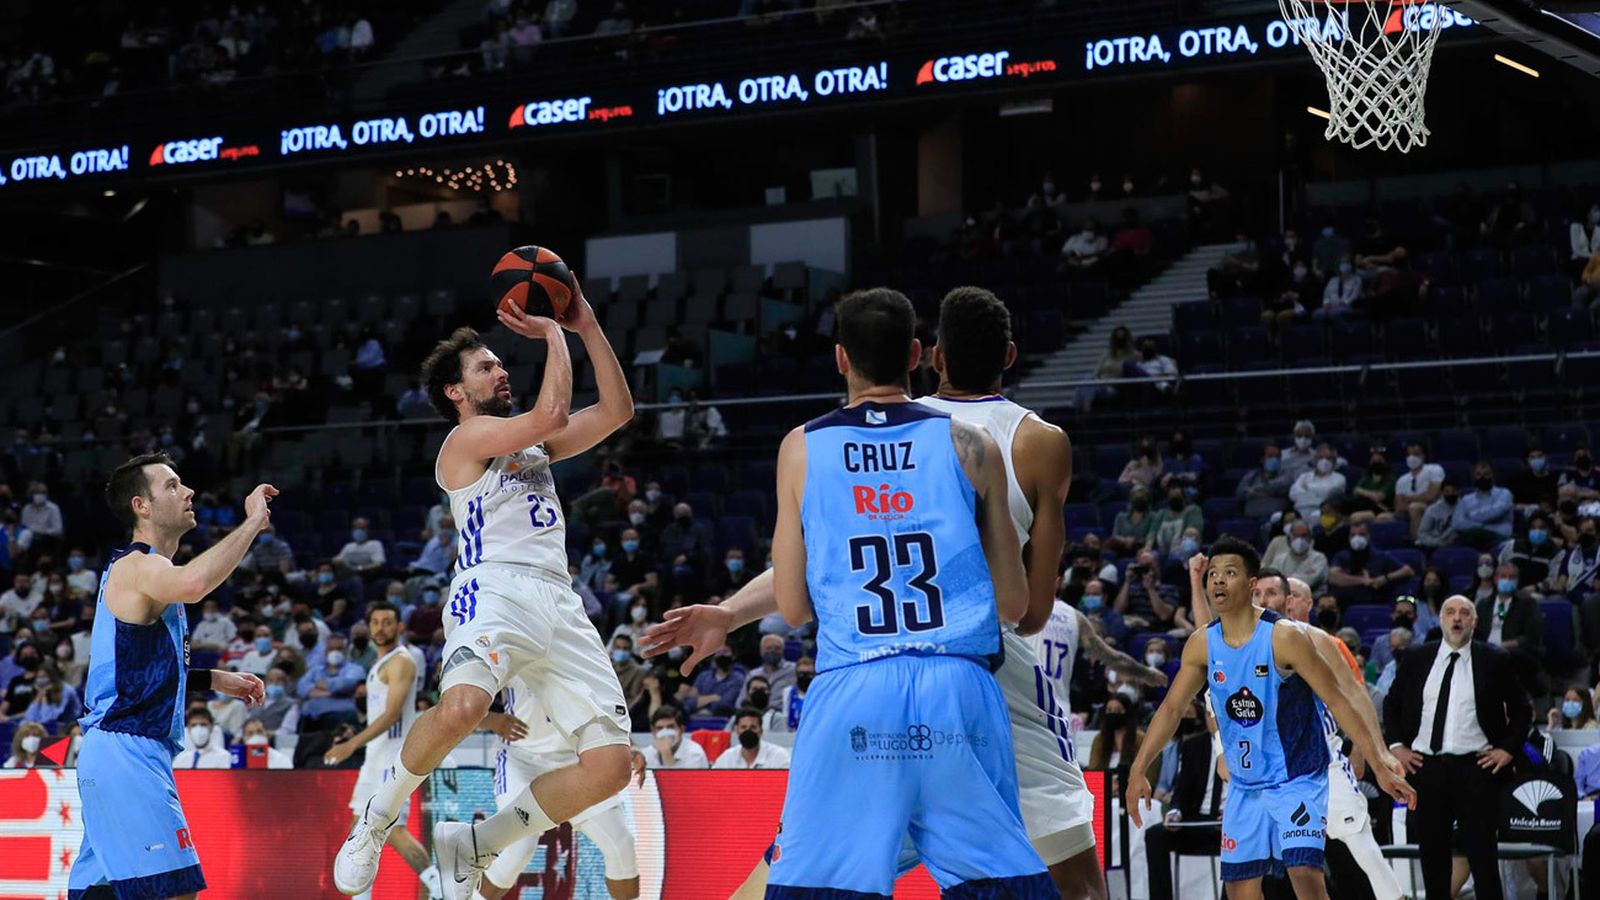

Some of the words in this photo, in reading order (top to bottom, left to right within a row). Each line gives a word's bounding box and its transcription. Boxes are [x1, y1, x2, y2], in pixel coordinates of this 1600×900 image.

[1402, 3, 1480, 33] case
[1085, 33, 1171, 70] ¡OTRA,
[1178, 25, 1258, 58] OTRA,
[933, 50, 1009, 83] caser
[1006, 60, 1057, 78] seguros
[657, 82, 733, 116] ¡OTRA,
[738, 74, 808, 105] OTRA,
[815, 61, 888, 97] OTRA!
[523, 96, 591, 126] caser
[280, 123, 348, 155] ¡OTRA,
[352, 116, 414, 146] OTRA,
[419, 106, 485, 138] OTRA!
[10, 154, 67, 181] OTRA,
[70, 145, 129, 174] OTRA!
[163, 136, 223, 164] caser
[843, 441, 916, 473] CRUZ
[853, 483, 914, 514] Río
[849, 532, 944, 636] 33
[1043, 639, 1069, 679] 17
[879, 740, 908, 751] LUGO
[1239, 740, 1252, 769] 2
[1282, 829, 1321, 840] CANDELAS
